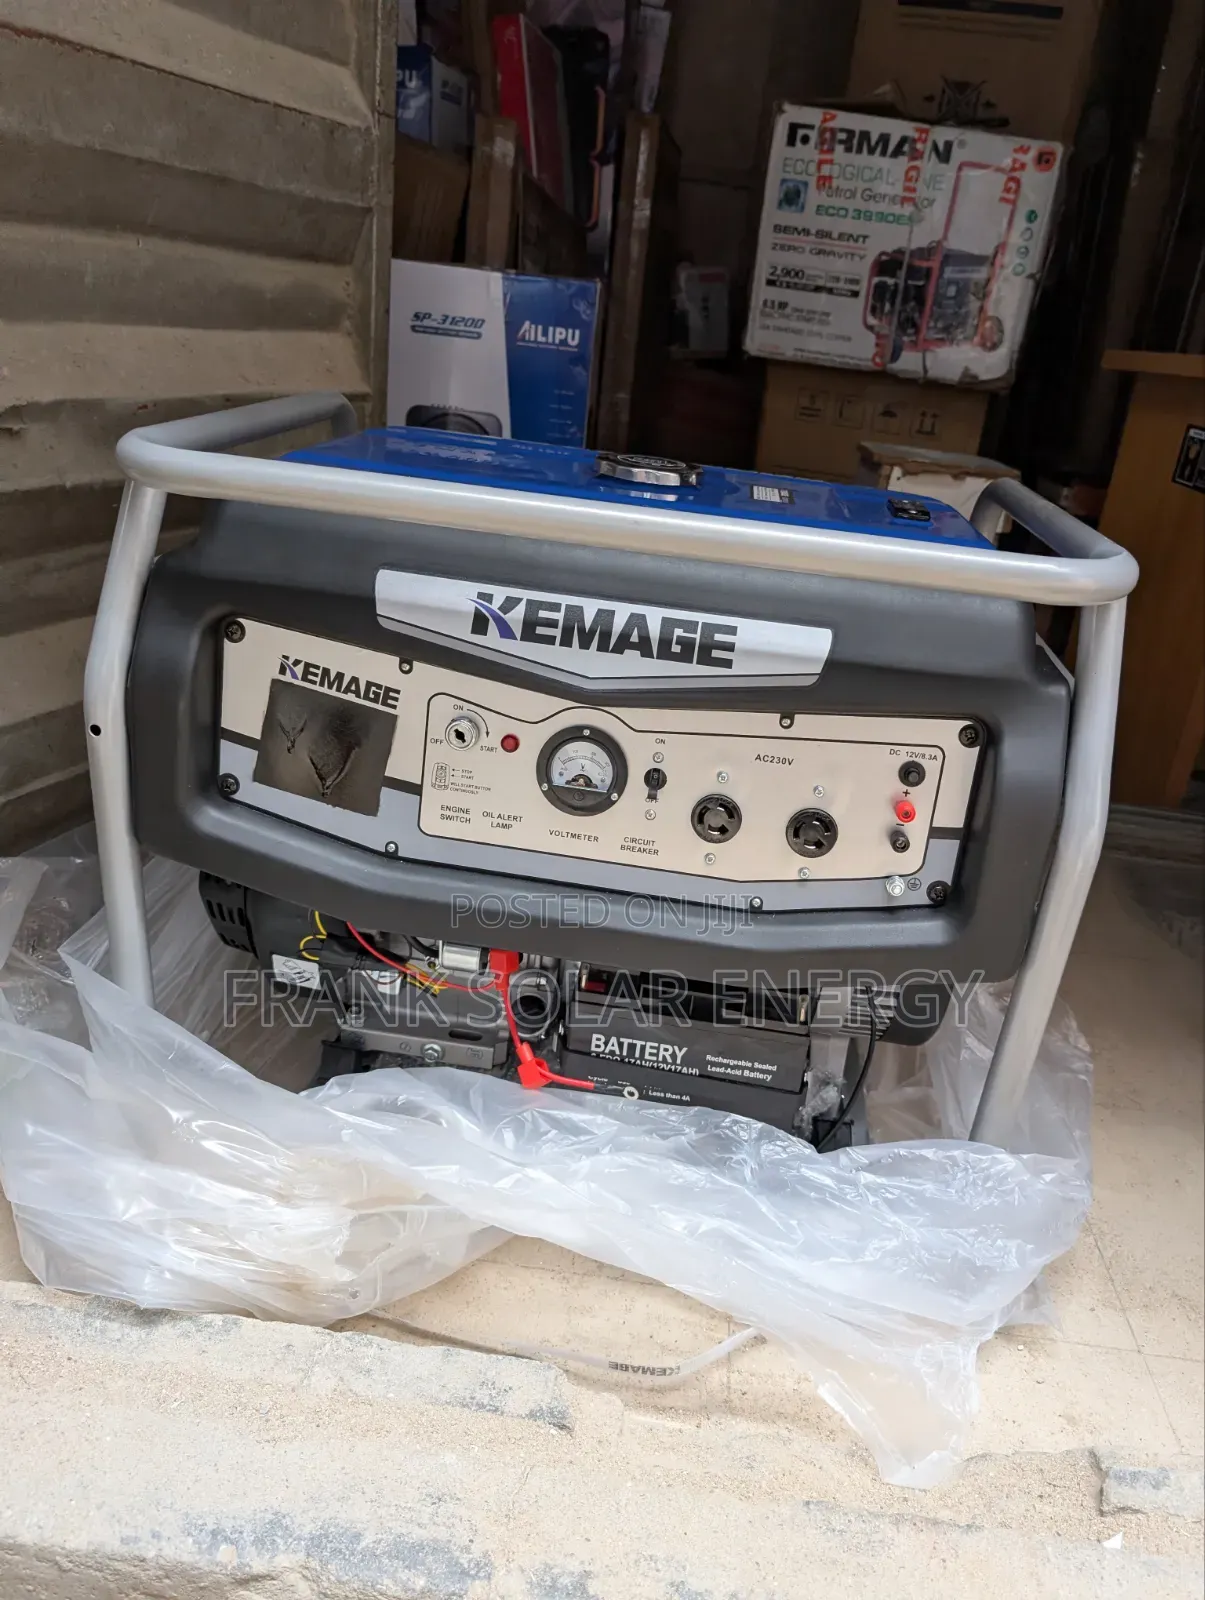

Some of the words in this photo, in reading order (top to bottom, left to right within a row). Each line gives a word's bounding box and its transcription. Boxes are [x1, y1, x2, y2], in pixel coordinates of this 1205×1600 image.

[815, 204, 848, 219] ECO
[773, 224, 869, 244] SEMI-SILENT
[809, 247, 867, 261] GRAVITY
[517, 320, 580, 346] AILIPU
[467, 592, 738, 669] KEMAGE
[277, 654, 401, 710] KEMAGE
[453, 704, 464, 712] ON
[480, 745, 498, 753] START
[889, 748, 901, 756] DC
[905, 751, 938, 762] 12V/8.3A
[754, 753, 795, 766] AC230V
[440, 804, 471, 815] ENGINE
[440, 813, 471, 824] SWITCH
[482, 811, 495, 819] OIL
[497, 813, 523, 823] ALERT
[491, 821, 513, 830] LAMP
[549, 829, 599, 842] VOLTMETER
[623, 836, 656, 847] CIRCUIT
[620, 845, 659, 856] BREAKER
[590, 1033, 688, 1064] BATTERY
[706, 1055, 752, 1068] Rechargeable
[753, 1062, 777, 1071] Sealed
[707, 1065, 742, 1075] Lead-Acid
[743, 1070, 772, 1082] Battery
[665, 1092, 680, 1100] than
[681, 1094, 690, 1102] 4A
[608, 1360, 681, 1377] KEMAGE
